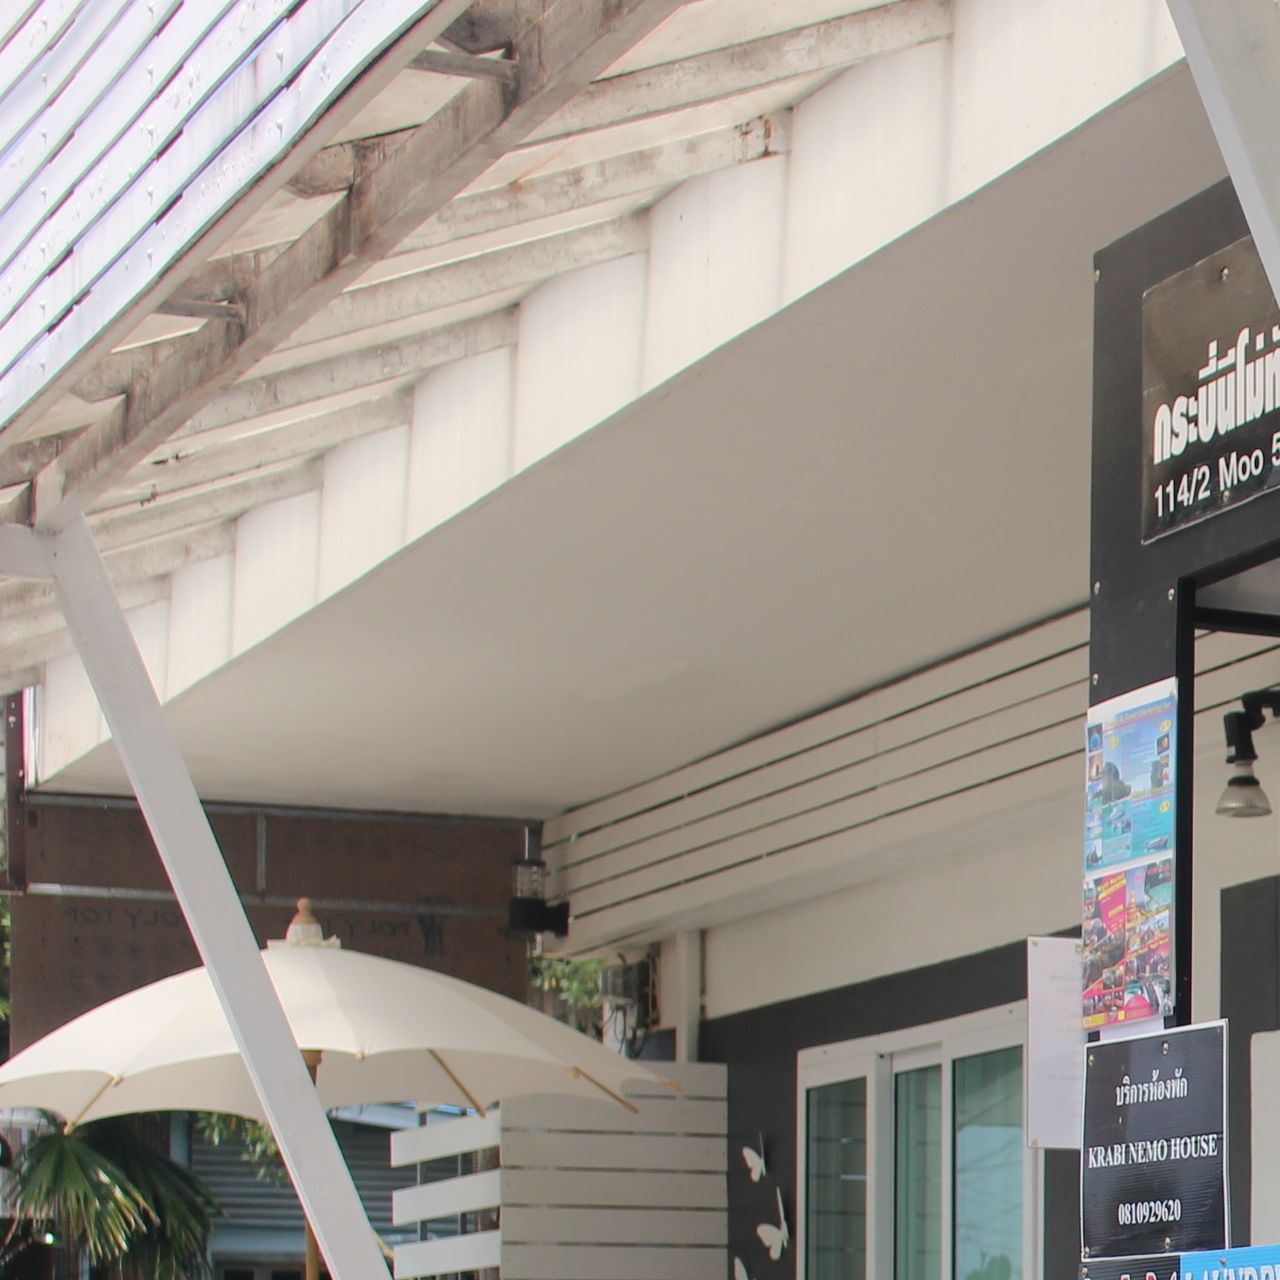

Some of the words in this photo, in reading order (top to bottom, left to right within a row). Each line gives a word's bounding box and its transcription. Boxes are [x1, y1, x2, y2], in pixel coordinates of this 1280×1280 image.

[1154, 465, 1211, 518] 114/2
[1218, 449, 1265, 492] Moo
[1115, 1067, 1188, 1107] บริการห้องพัก
[1087, 1143, 1126, 1169] KRABI
[1128, 1138, 1168, 1165] NEMO
[1170, 1133, 1219, 1160] HOUSE
[1117, 1198, 1182, 1226] 0810929620
